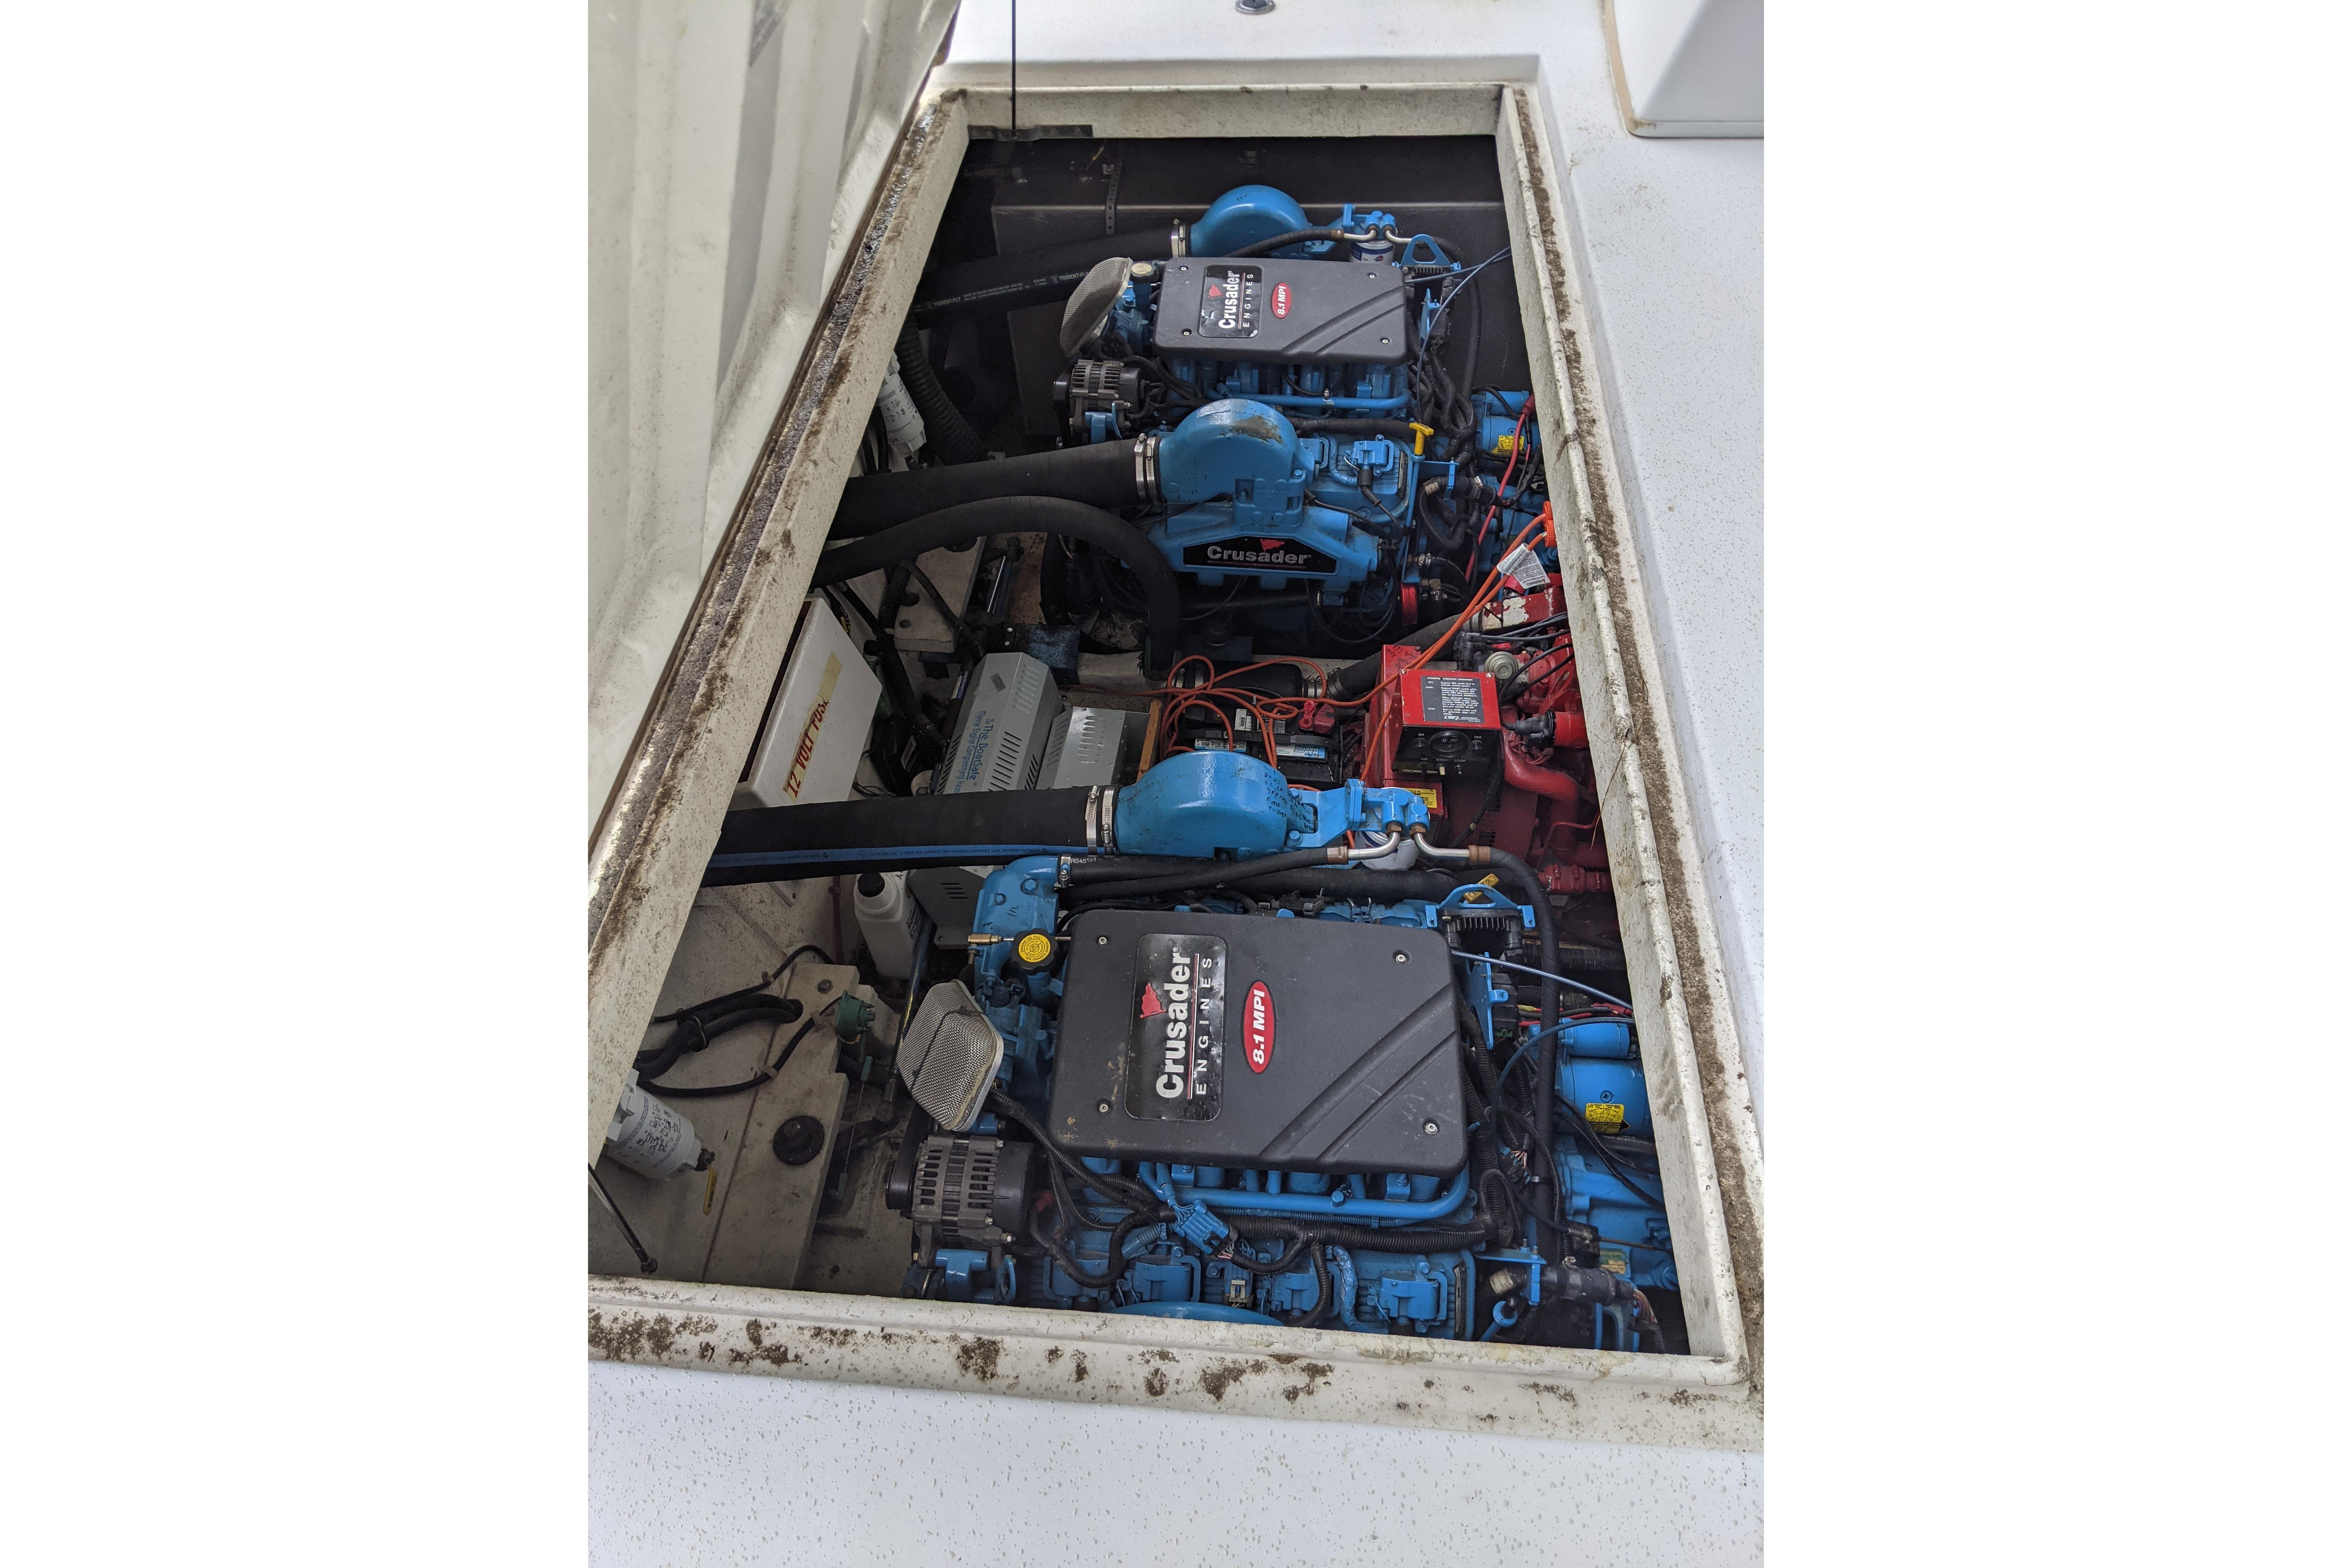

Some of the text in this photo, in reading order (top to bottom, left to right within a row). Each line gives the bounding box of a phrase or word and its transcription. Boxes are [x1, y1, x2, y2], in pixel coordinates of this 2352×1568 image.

[1218, 271, 1240, 329] Crusader
[1243, 274, 1253, 327] ENGINES
[1278, 286, 1286, 302] MPI
[1207, 546, 1308, 565] Crusader
[968, 728, 980, 744] Engine
[973, 710, 986, 726] Marine
[969, 724, 994, 780] The BoatSafe
[788, 771, 801, 798] 12
[1156, 952, 1190, 1098] Crusader
[1196, 957, 1213, 1095] ENGINES
[1253, 989, 1265, 1065] 8.1 MPI
